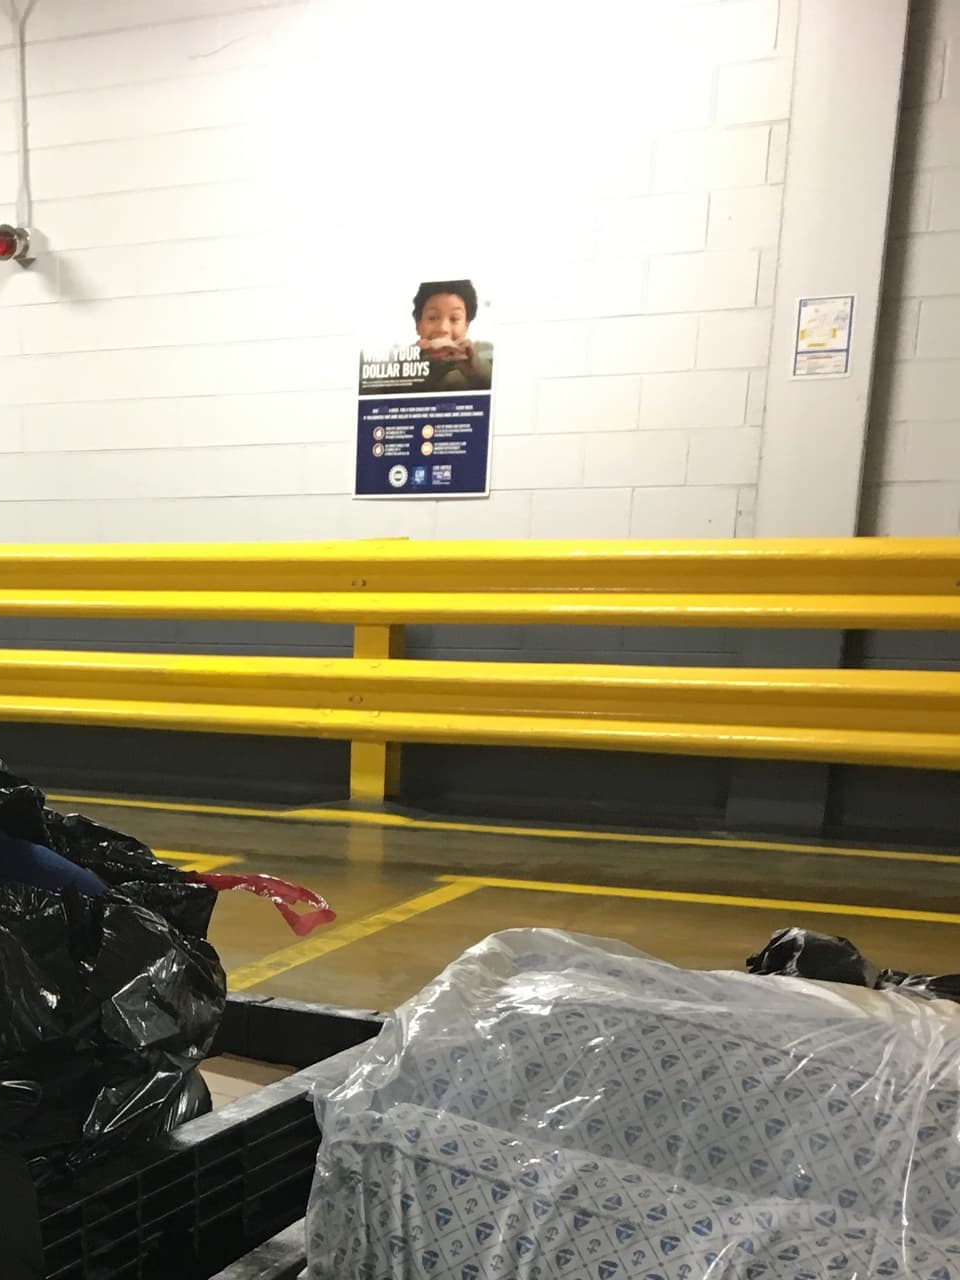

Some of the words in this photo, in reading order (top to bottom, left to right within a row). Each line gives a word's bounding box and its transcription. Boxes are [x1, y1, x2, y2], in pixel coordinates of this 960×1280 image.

[393, 344, 421, 361] YOUR
[362, 363, 400, 379] DOLLAR
[402, 361, 430, 377] BUYS
